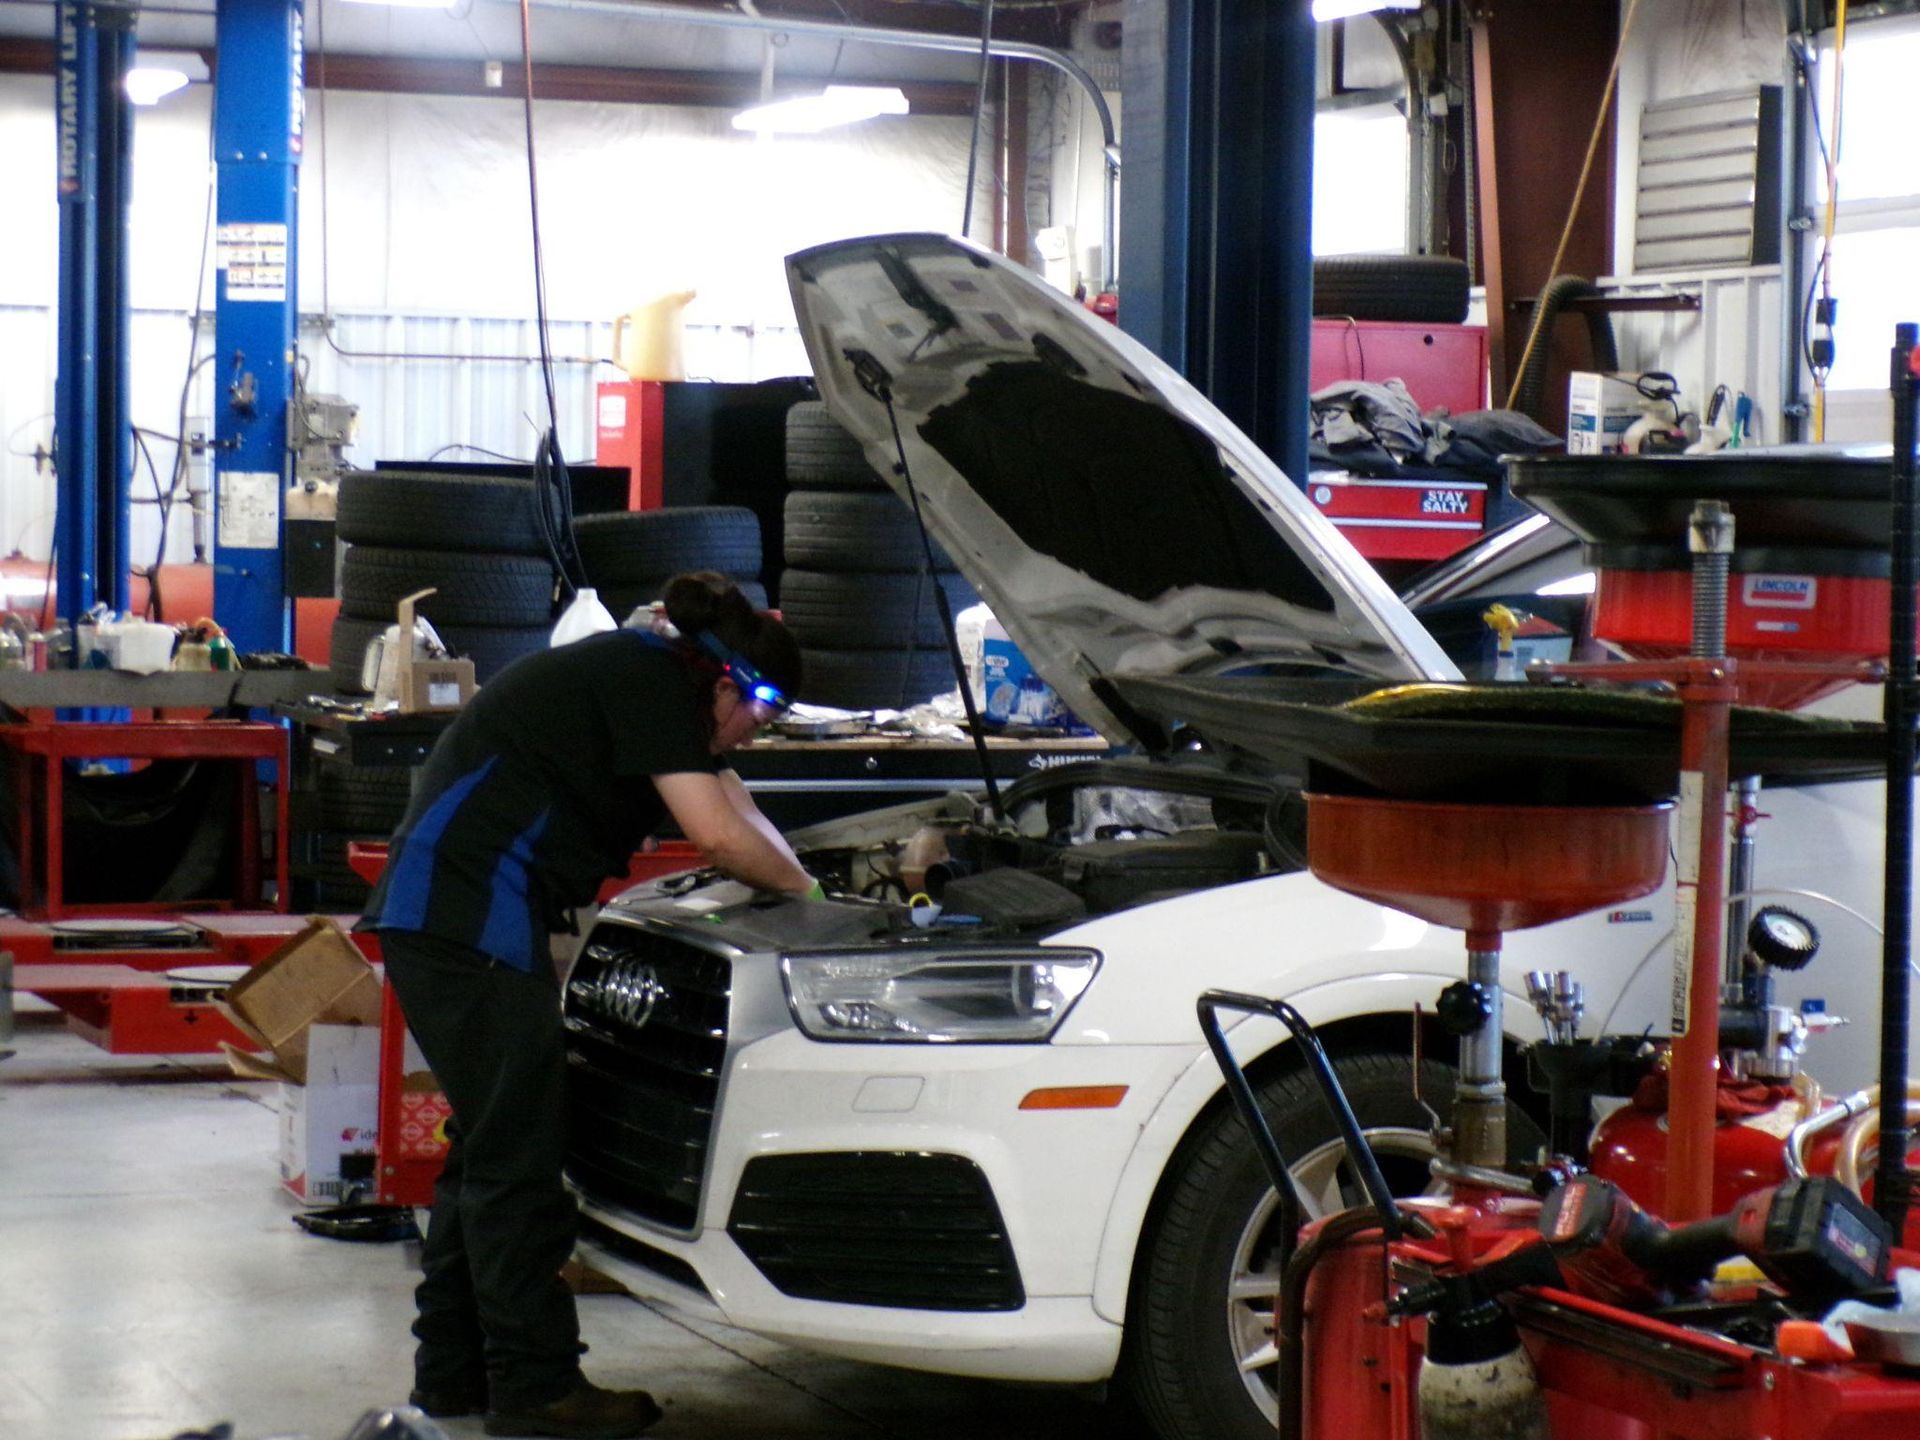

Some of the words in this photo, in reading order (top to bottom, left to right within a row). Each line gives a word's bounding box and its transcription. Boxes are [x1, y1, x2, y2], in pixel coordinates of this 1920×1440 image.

[61, 4, 78, 60] LIFT
[60, 68, 77, 178] ROTARY
[1427, 490, 1464, 503] STAY
[1422, 501, 1469, 514] SALTY
[1754, 578, 1809, 592] LINCOLN
